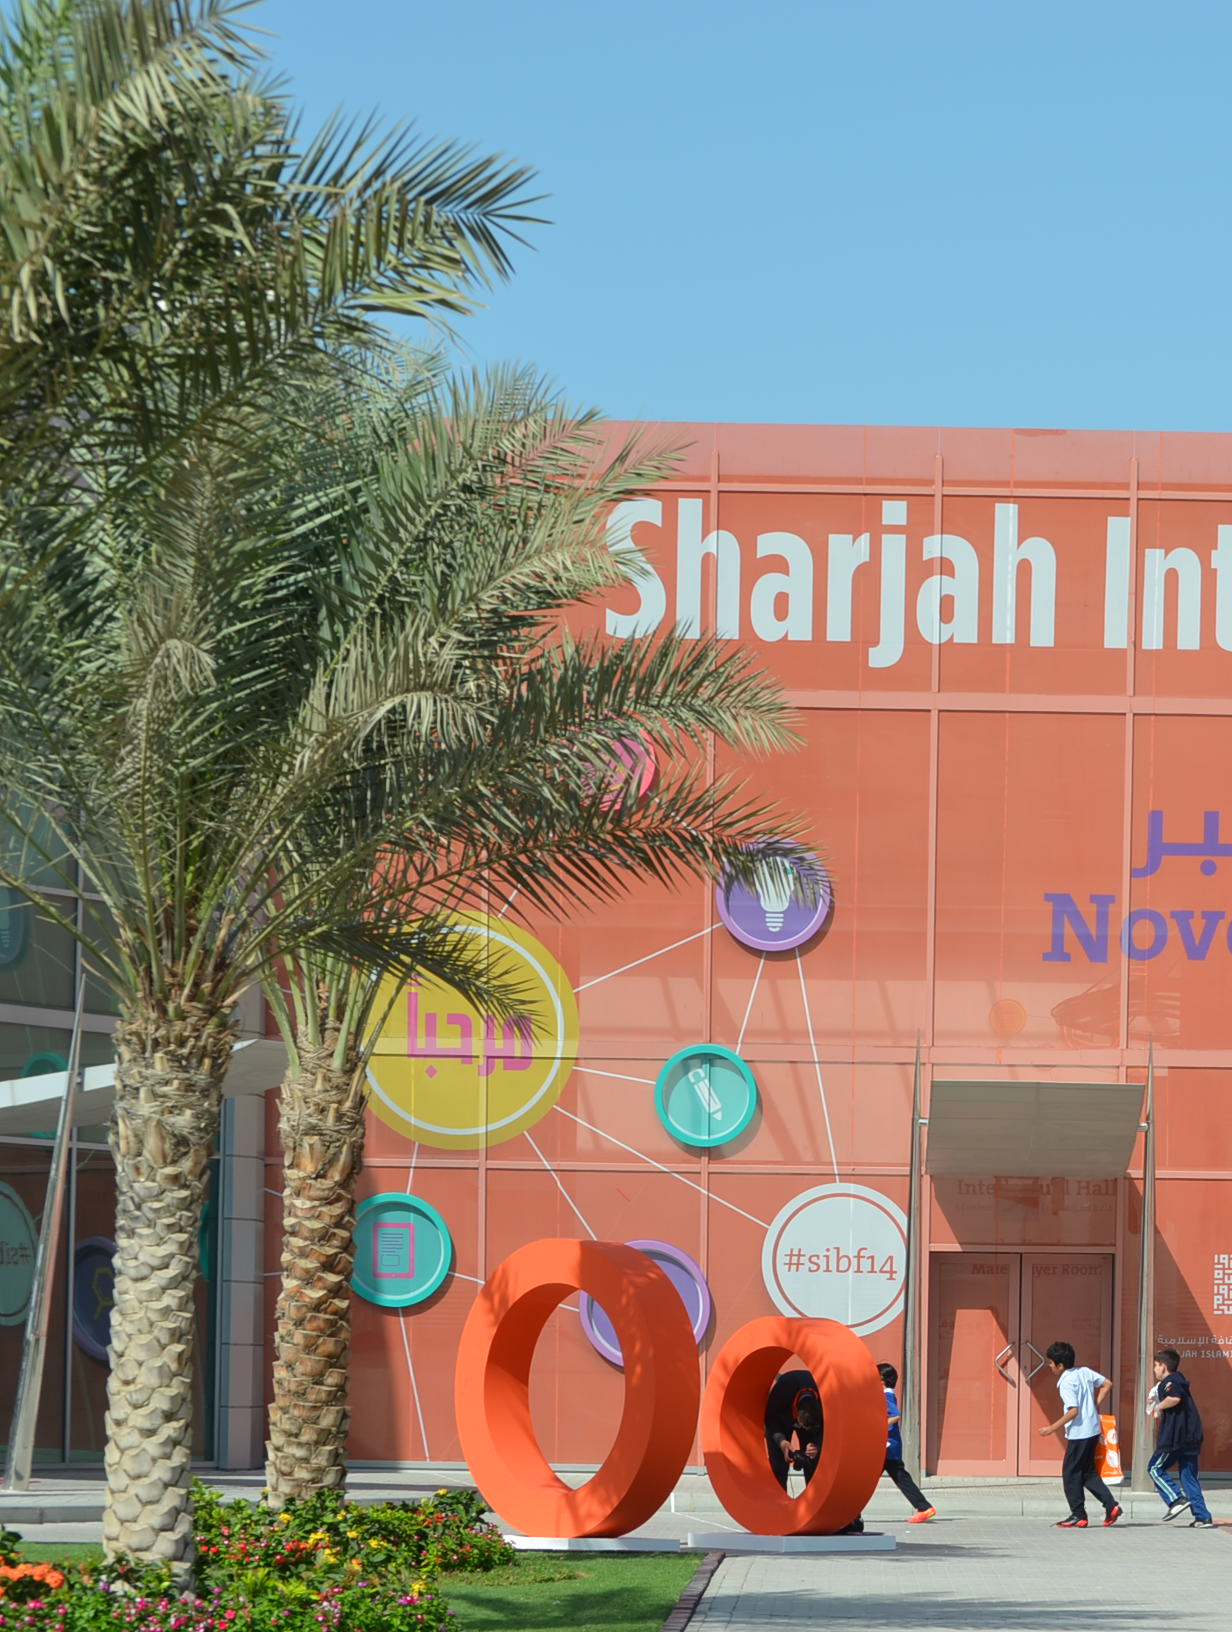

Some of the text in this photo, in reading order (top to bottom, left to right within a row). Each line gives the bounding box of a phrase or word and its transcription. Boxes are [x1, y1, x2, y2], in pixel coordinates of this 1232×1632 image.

[605, 497, 1057, 668] Sharjah
[1076, 1178, 1118, 1197] Hall
[783, 1246, 898, 1281] #sibf14
